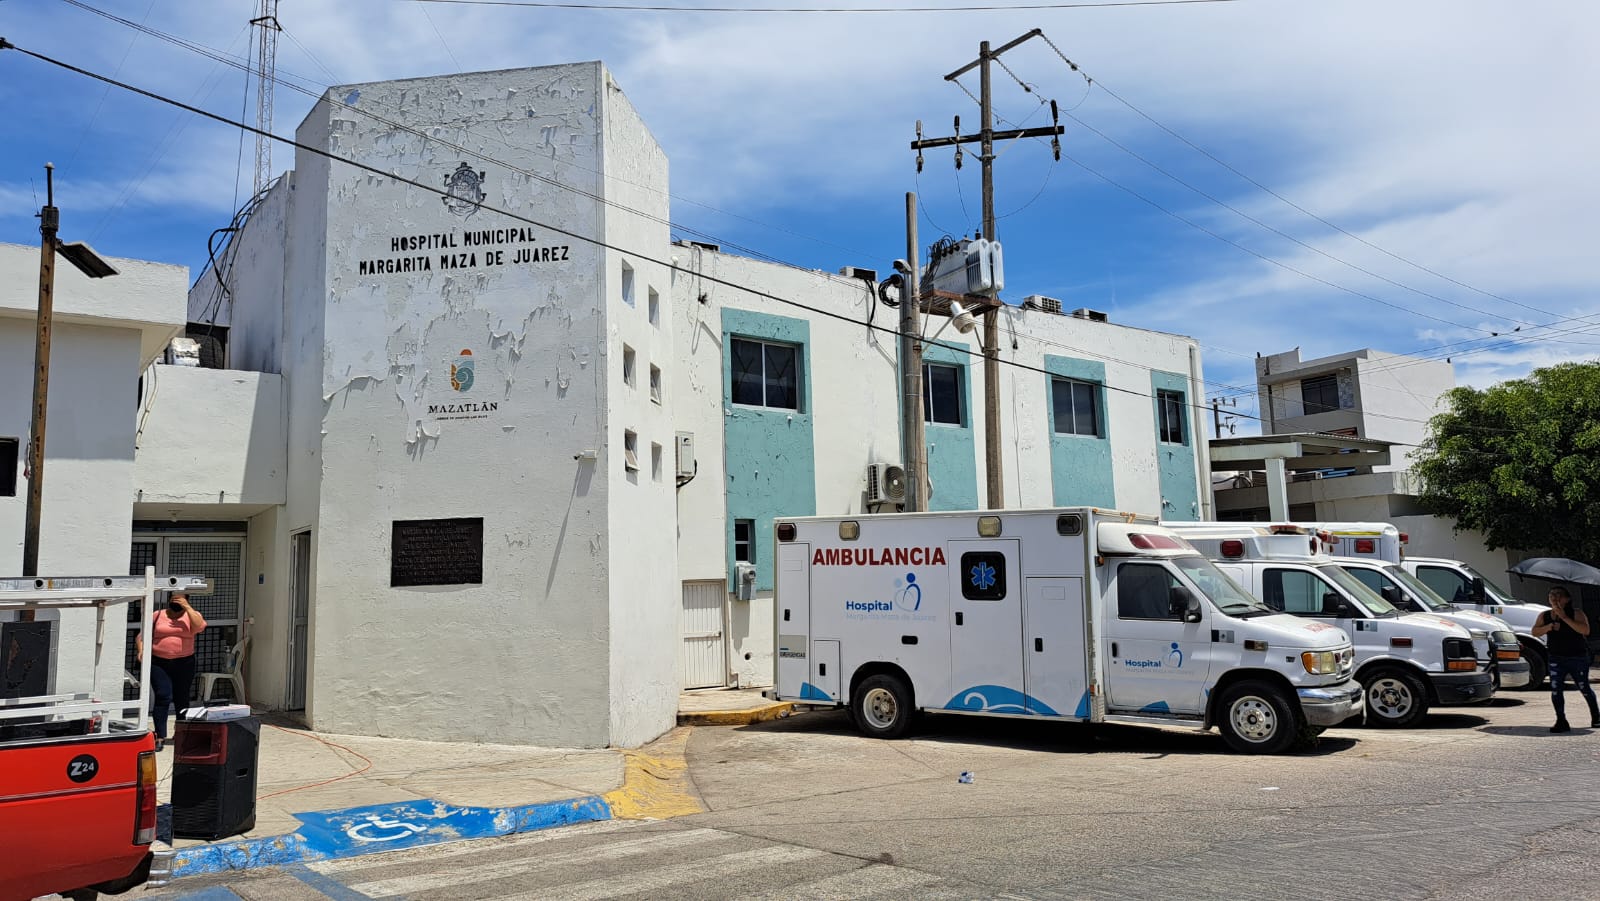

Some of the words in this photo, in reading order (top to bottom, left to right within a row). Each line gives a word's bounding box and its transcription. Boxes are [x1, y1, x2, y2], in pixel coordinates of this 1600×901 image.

[391, 233, 458, 252] HOSPITAL
[464, 227, 536, 247] MUNICIPAL
[359, 256, 431, 275] MARGARITA
[440, 253, 476, 270] MAZA
[486, 250, 504, 266] DE
[513, 246, 569, 264] JUAREZ
[812, 547, 946, 566] AMBULANCIA
[846, 600, 893, 612] Hospital
[1125, 659, 1162, 668] Hospital
